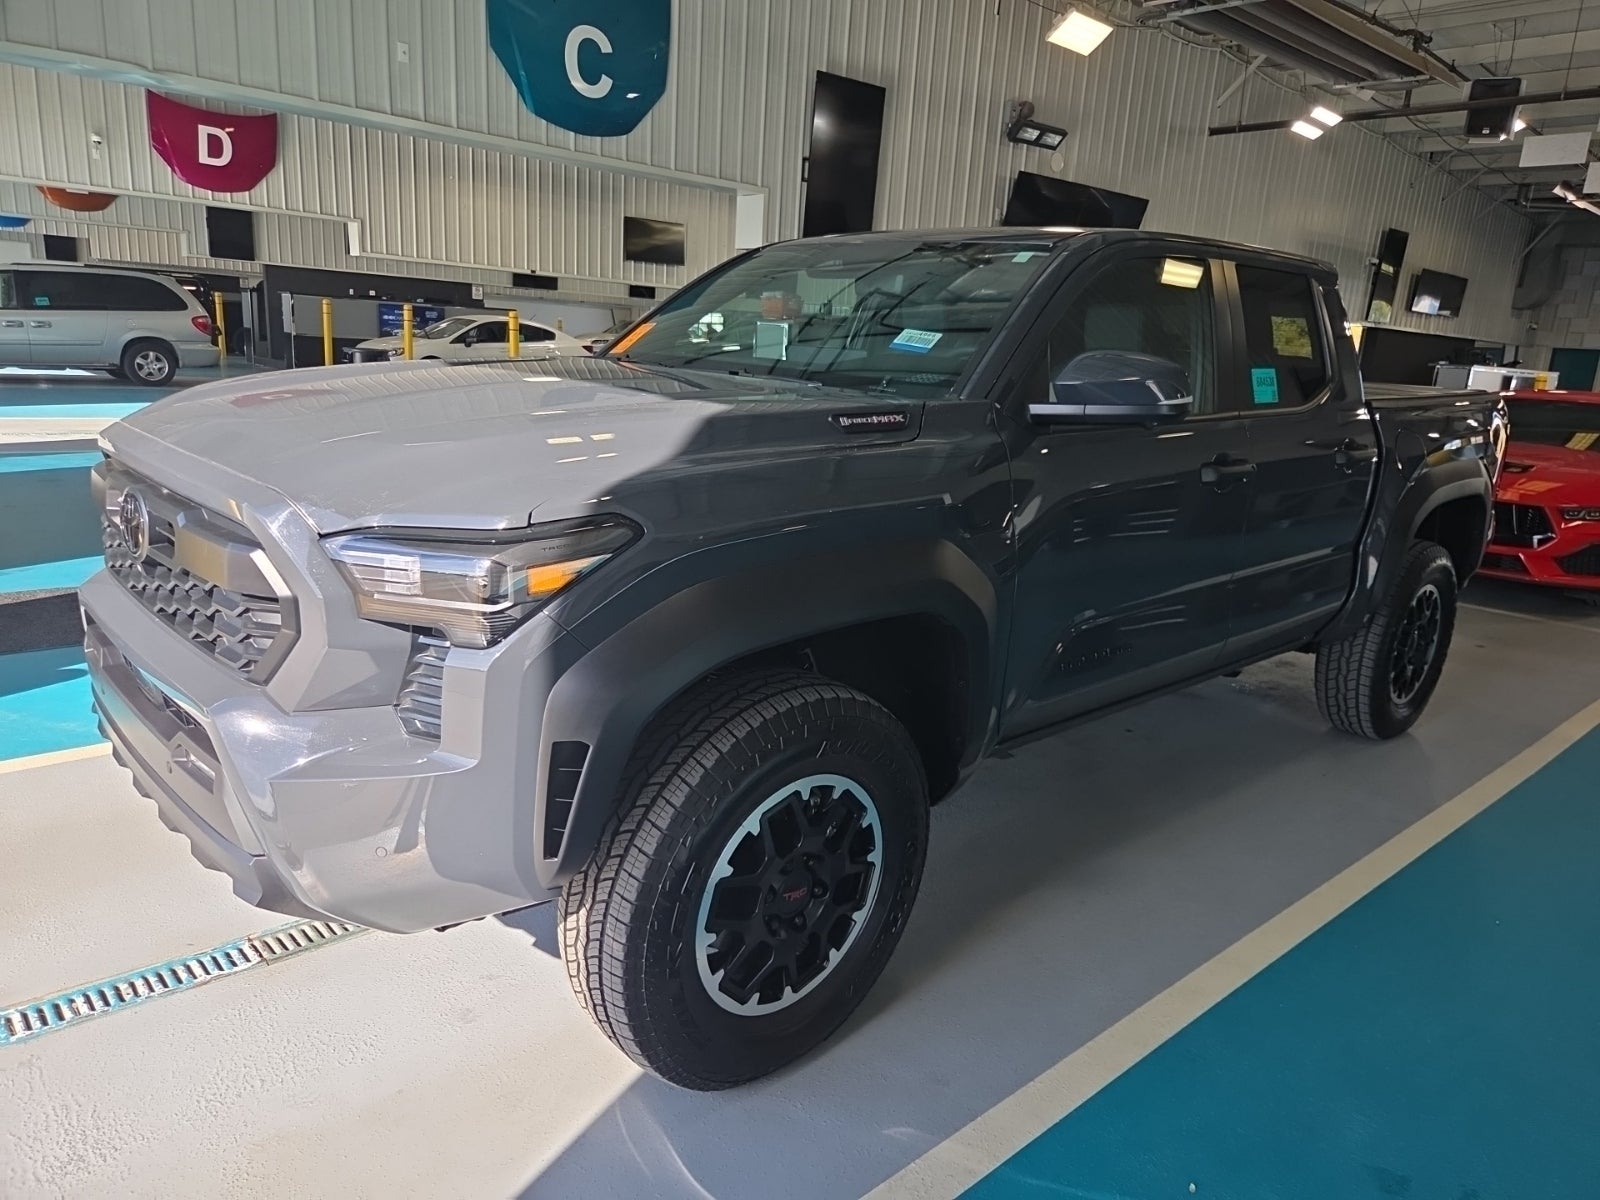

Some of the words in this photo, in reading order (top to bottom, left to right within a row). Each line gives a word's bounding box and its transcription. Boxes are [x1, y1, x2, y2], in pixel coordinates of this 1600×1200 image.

[564, 24, 613, 99] C
[198, 124, 233, 167] D
[782, 887, 808, 902] TRD
